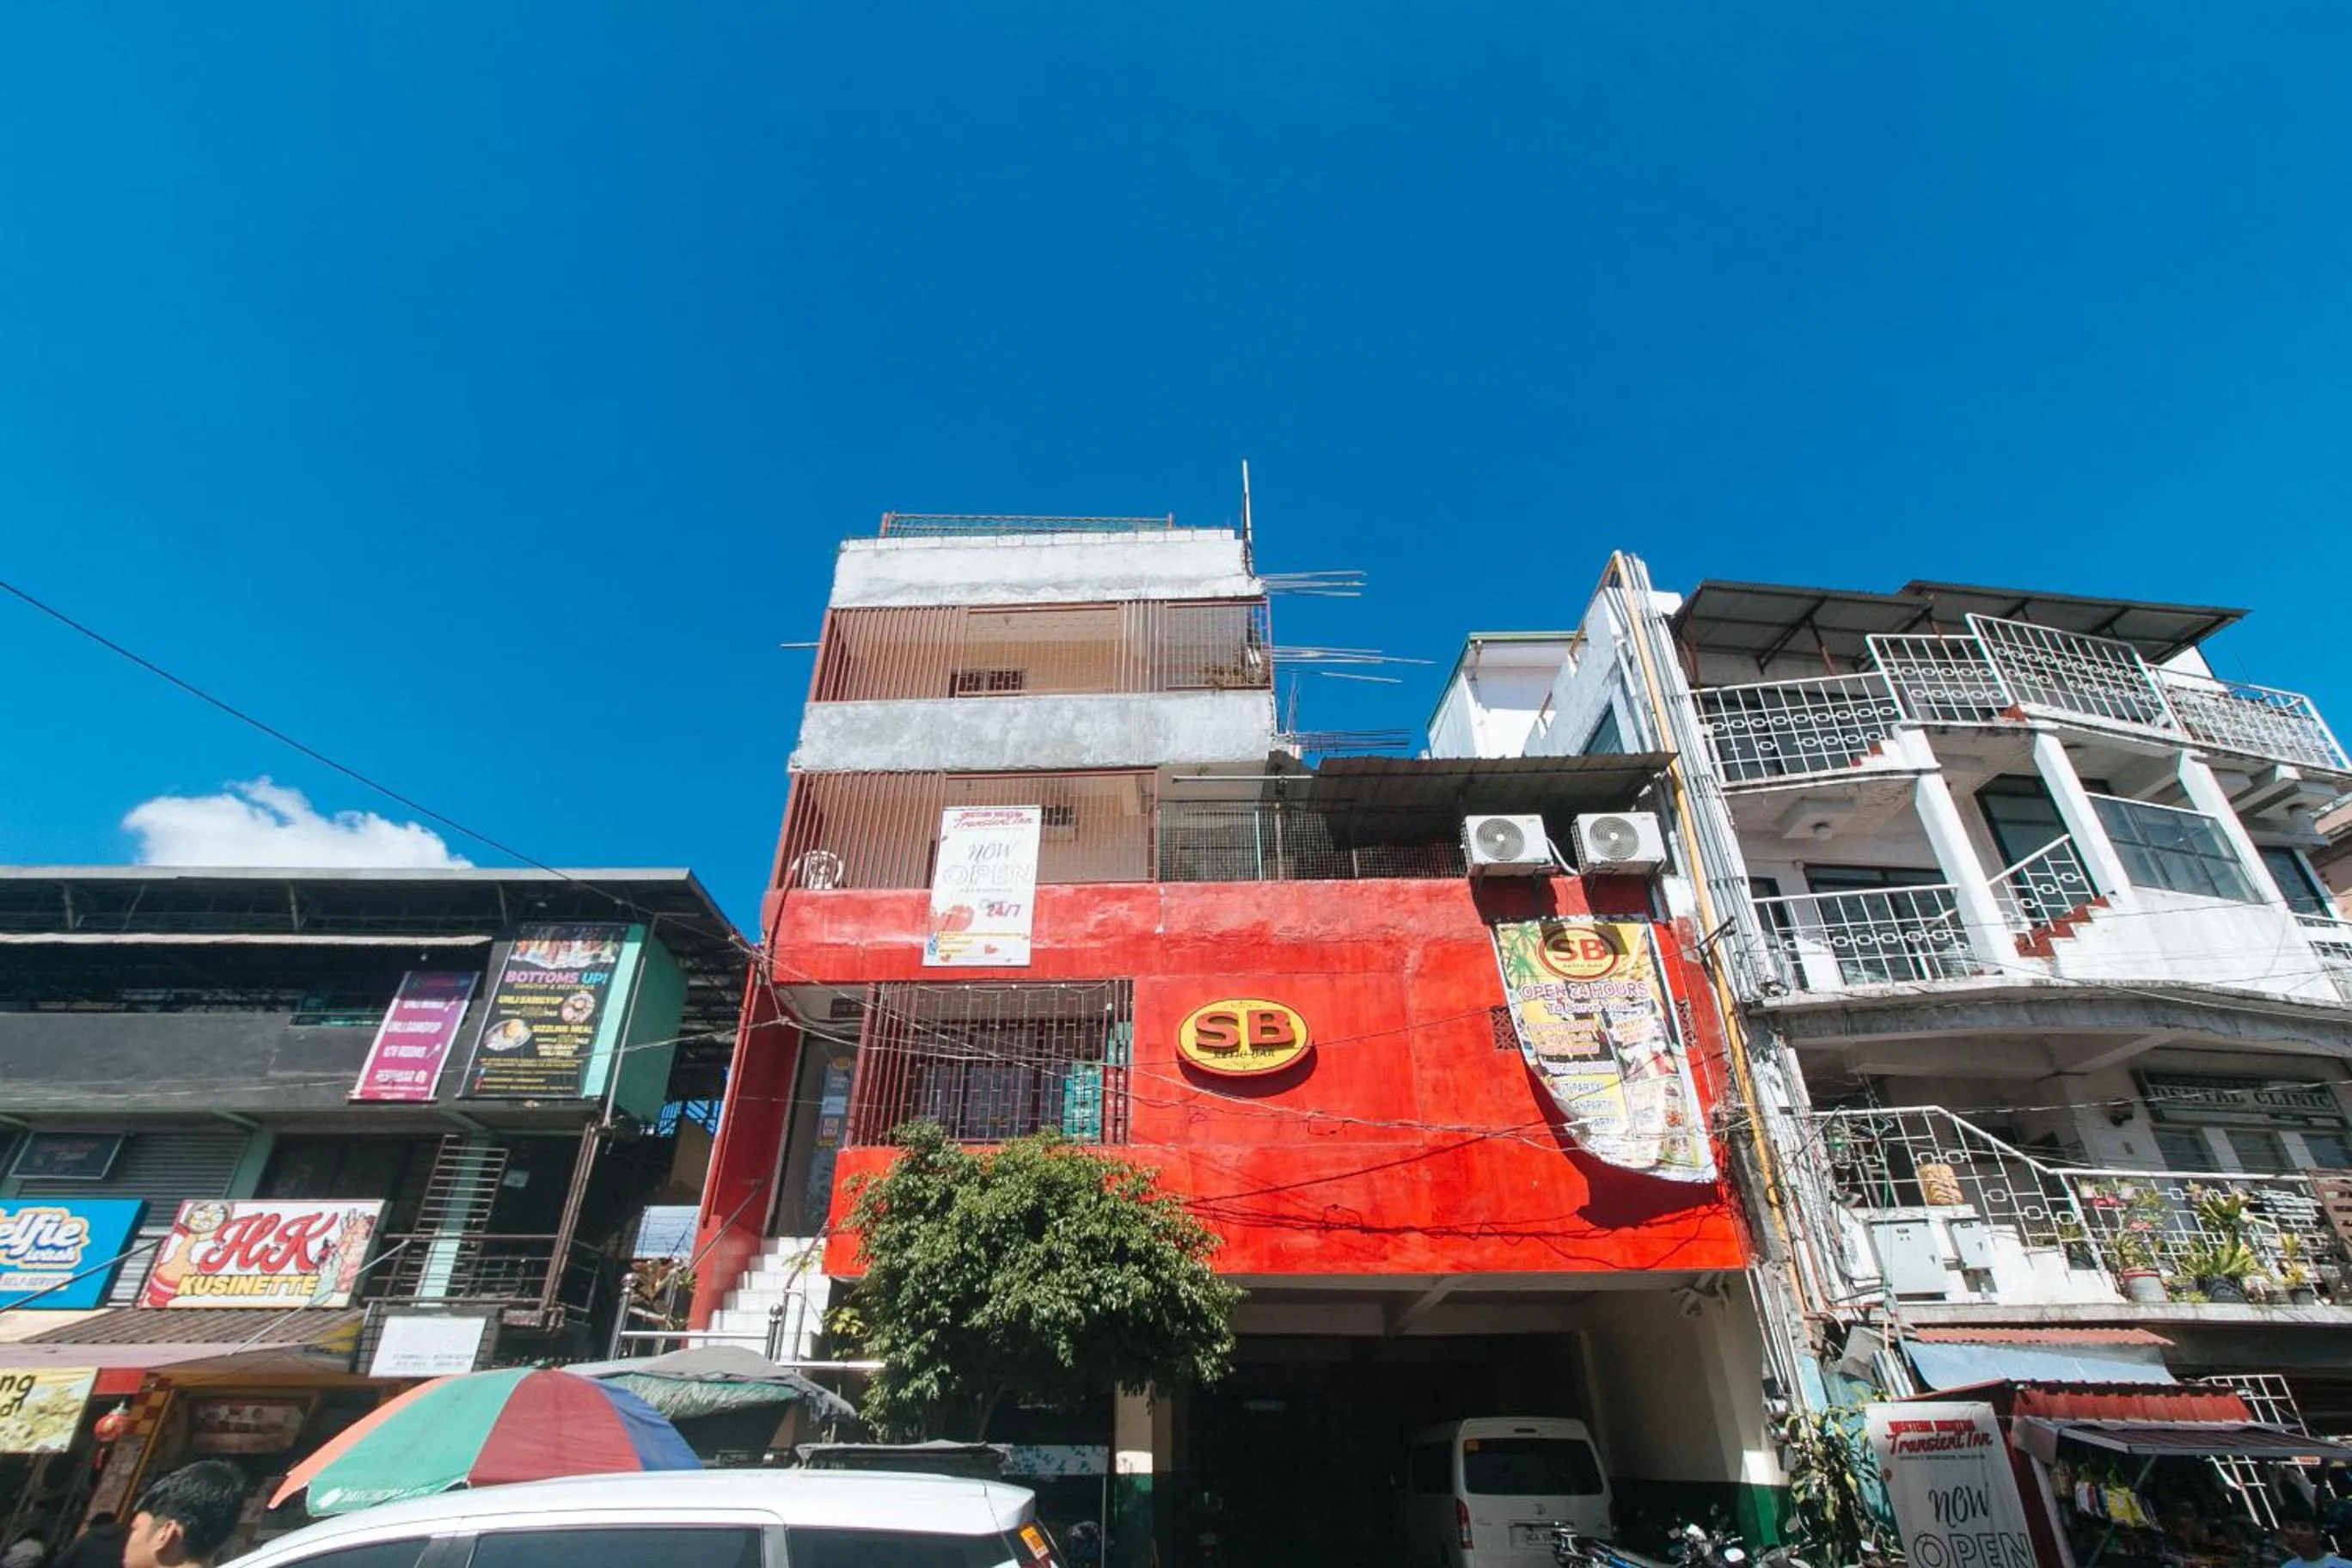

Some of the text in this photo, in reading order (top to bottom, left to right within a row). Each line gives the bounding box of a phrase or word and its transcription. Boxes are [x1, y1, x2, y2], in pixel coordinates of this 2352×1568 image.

[968, 840, 1018, 863] NOW
[943, 864, 1033, 886] OPEN
[1551, 938, 1608, 962] SB
[505, 970, 609, 984] BOTTOMS UP!
[1522, 982, 1649, 999] OPEN 24 HOURS
[1547, 1001, 1563, 1014] To
[1194, 1009, 1297, 1051] SB
[2149, 1086, 2333, 1108] DENTAL CLINIC
[178, 1274, 321, 1296] KUSINETTE
[1885, 1429, 1994, 1455] Transient Inn
[1913, 1532, 2038, 1568] OPEN
